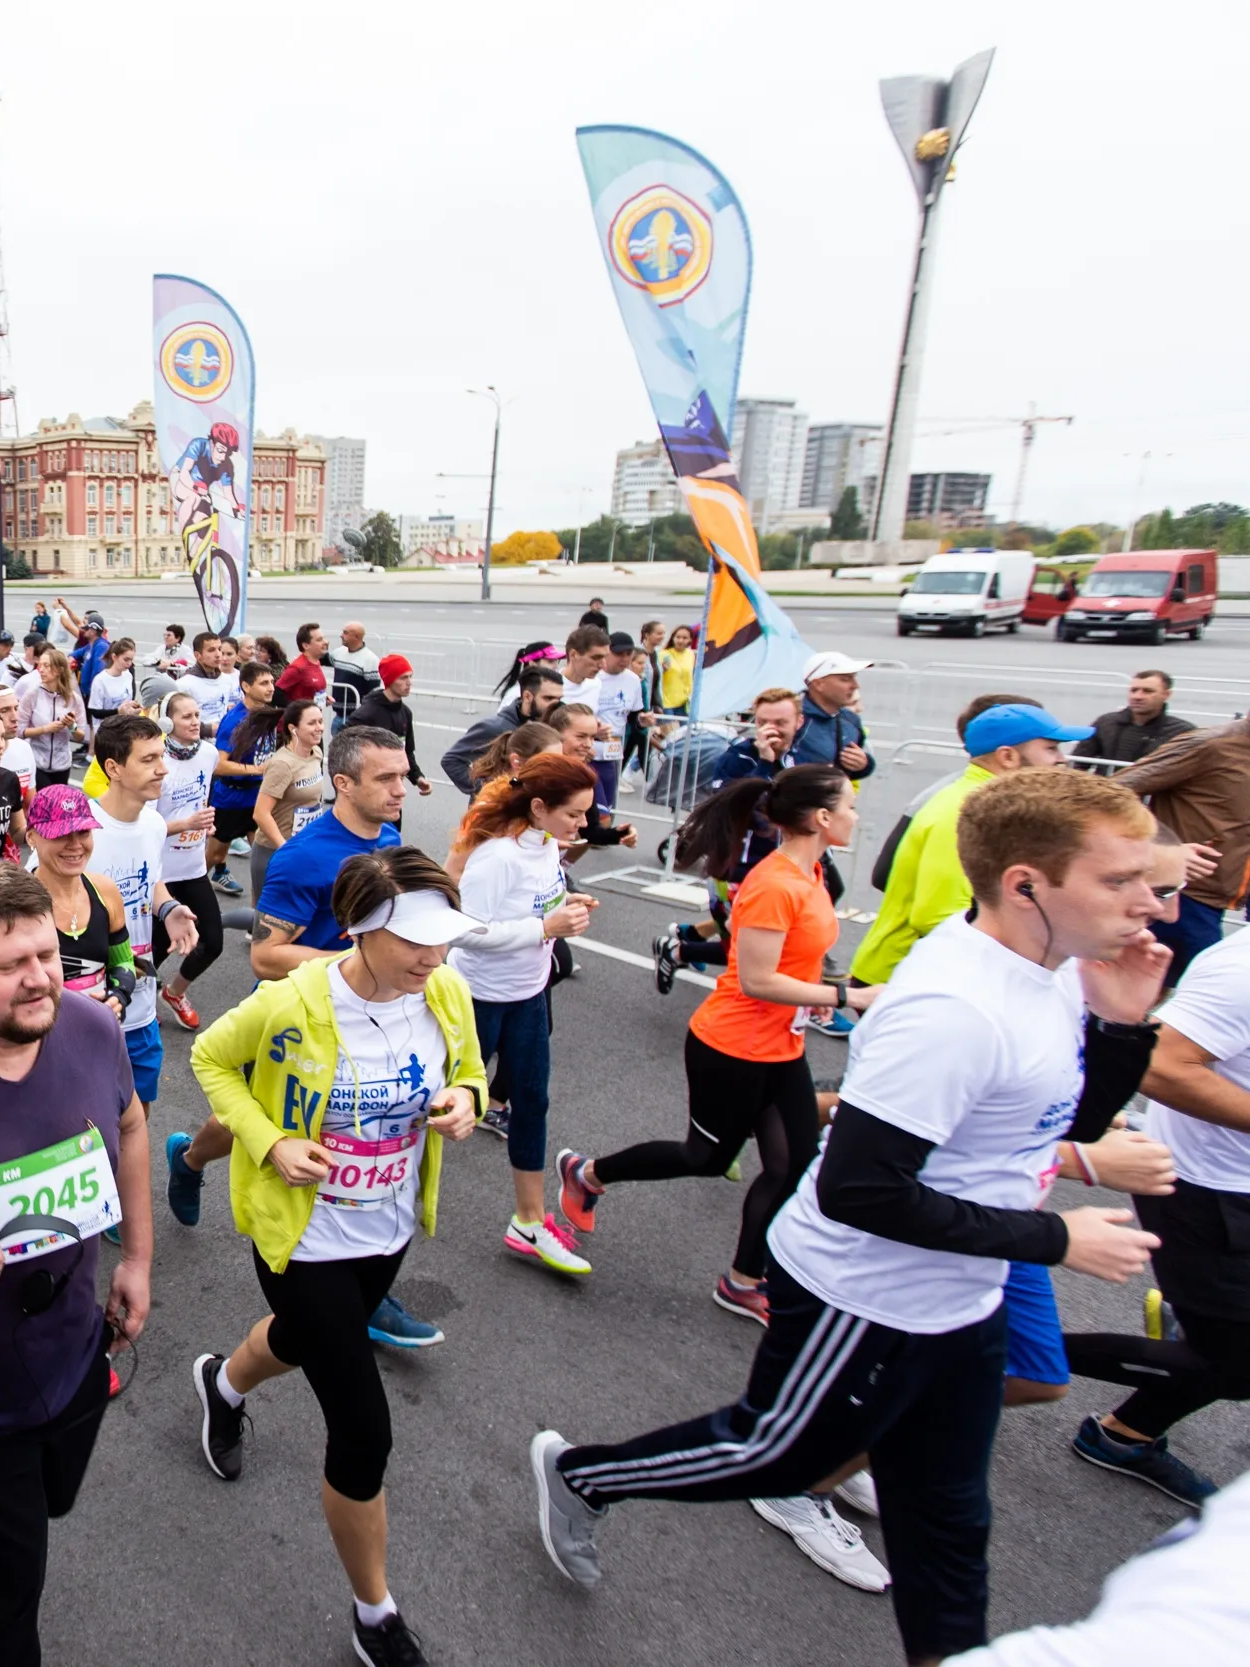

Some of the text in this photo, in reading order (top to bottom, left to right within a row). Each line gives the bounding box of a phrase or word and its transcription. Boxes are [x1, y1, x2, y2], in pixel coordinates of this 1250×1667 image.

[329, 1085, 388, 1099] ОНСКОЙ
[389, 1124, 400, 1134] 6
[328, 1157, 408, 1189] 10143
[8, 1166, 99, 1218] 2045
